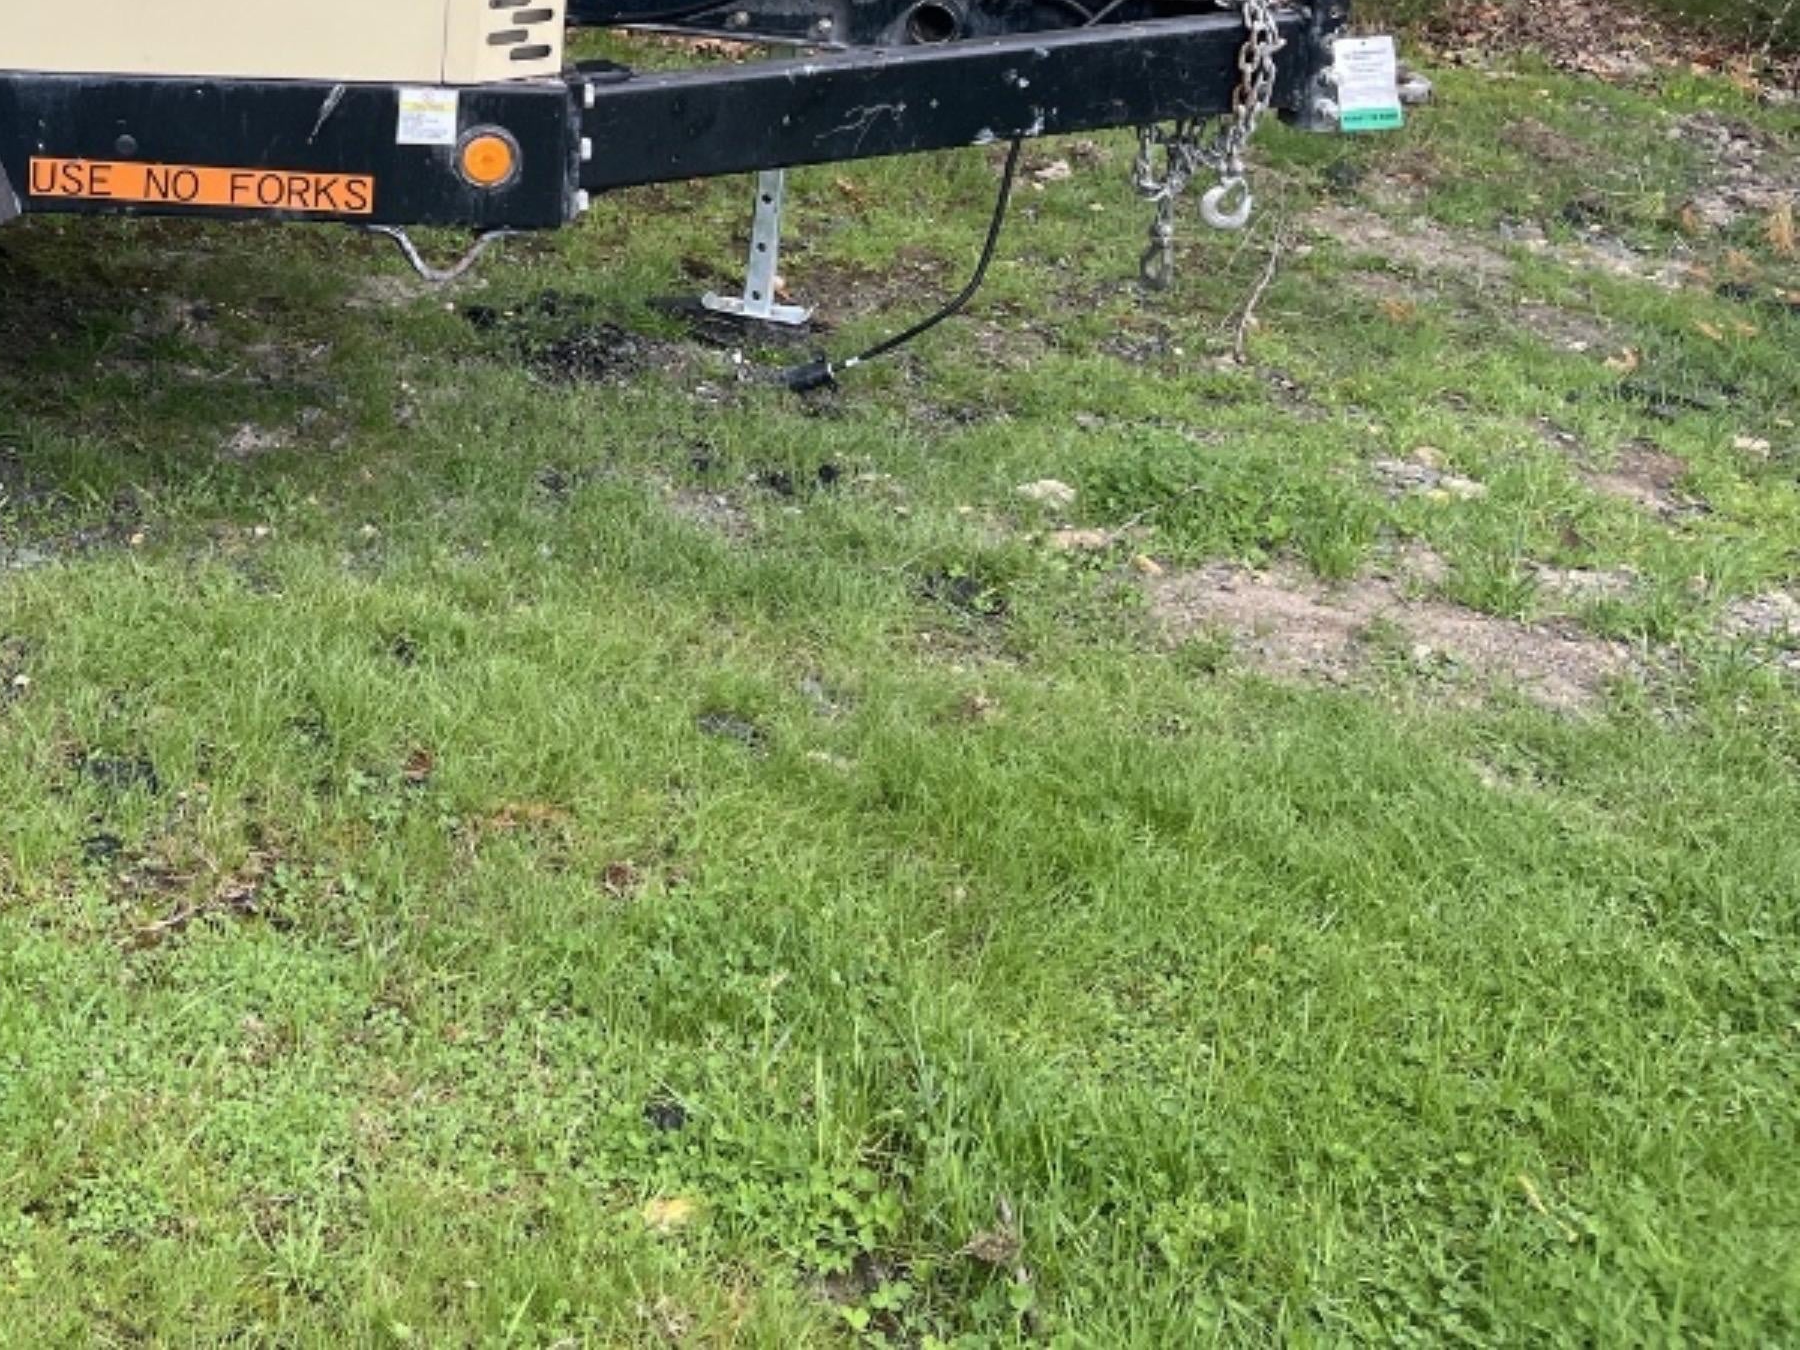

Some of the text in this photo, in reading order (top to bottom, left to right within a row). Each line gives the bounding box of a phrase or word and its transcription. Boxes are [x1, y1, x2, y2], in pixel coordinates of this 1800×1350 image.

[32, 161, 368, 211] USE NO FORKS
